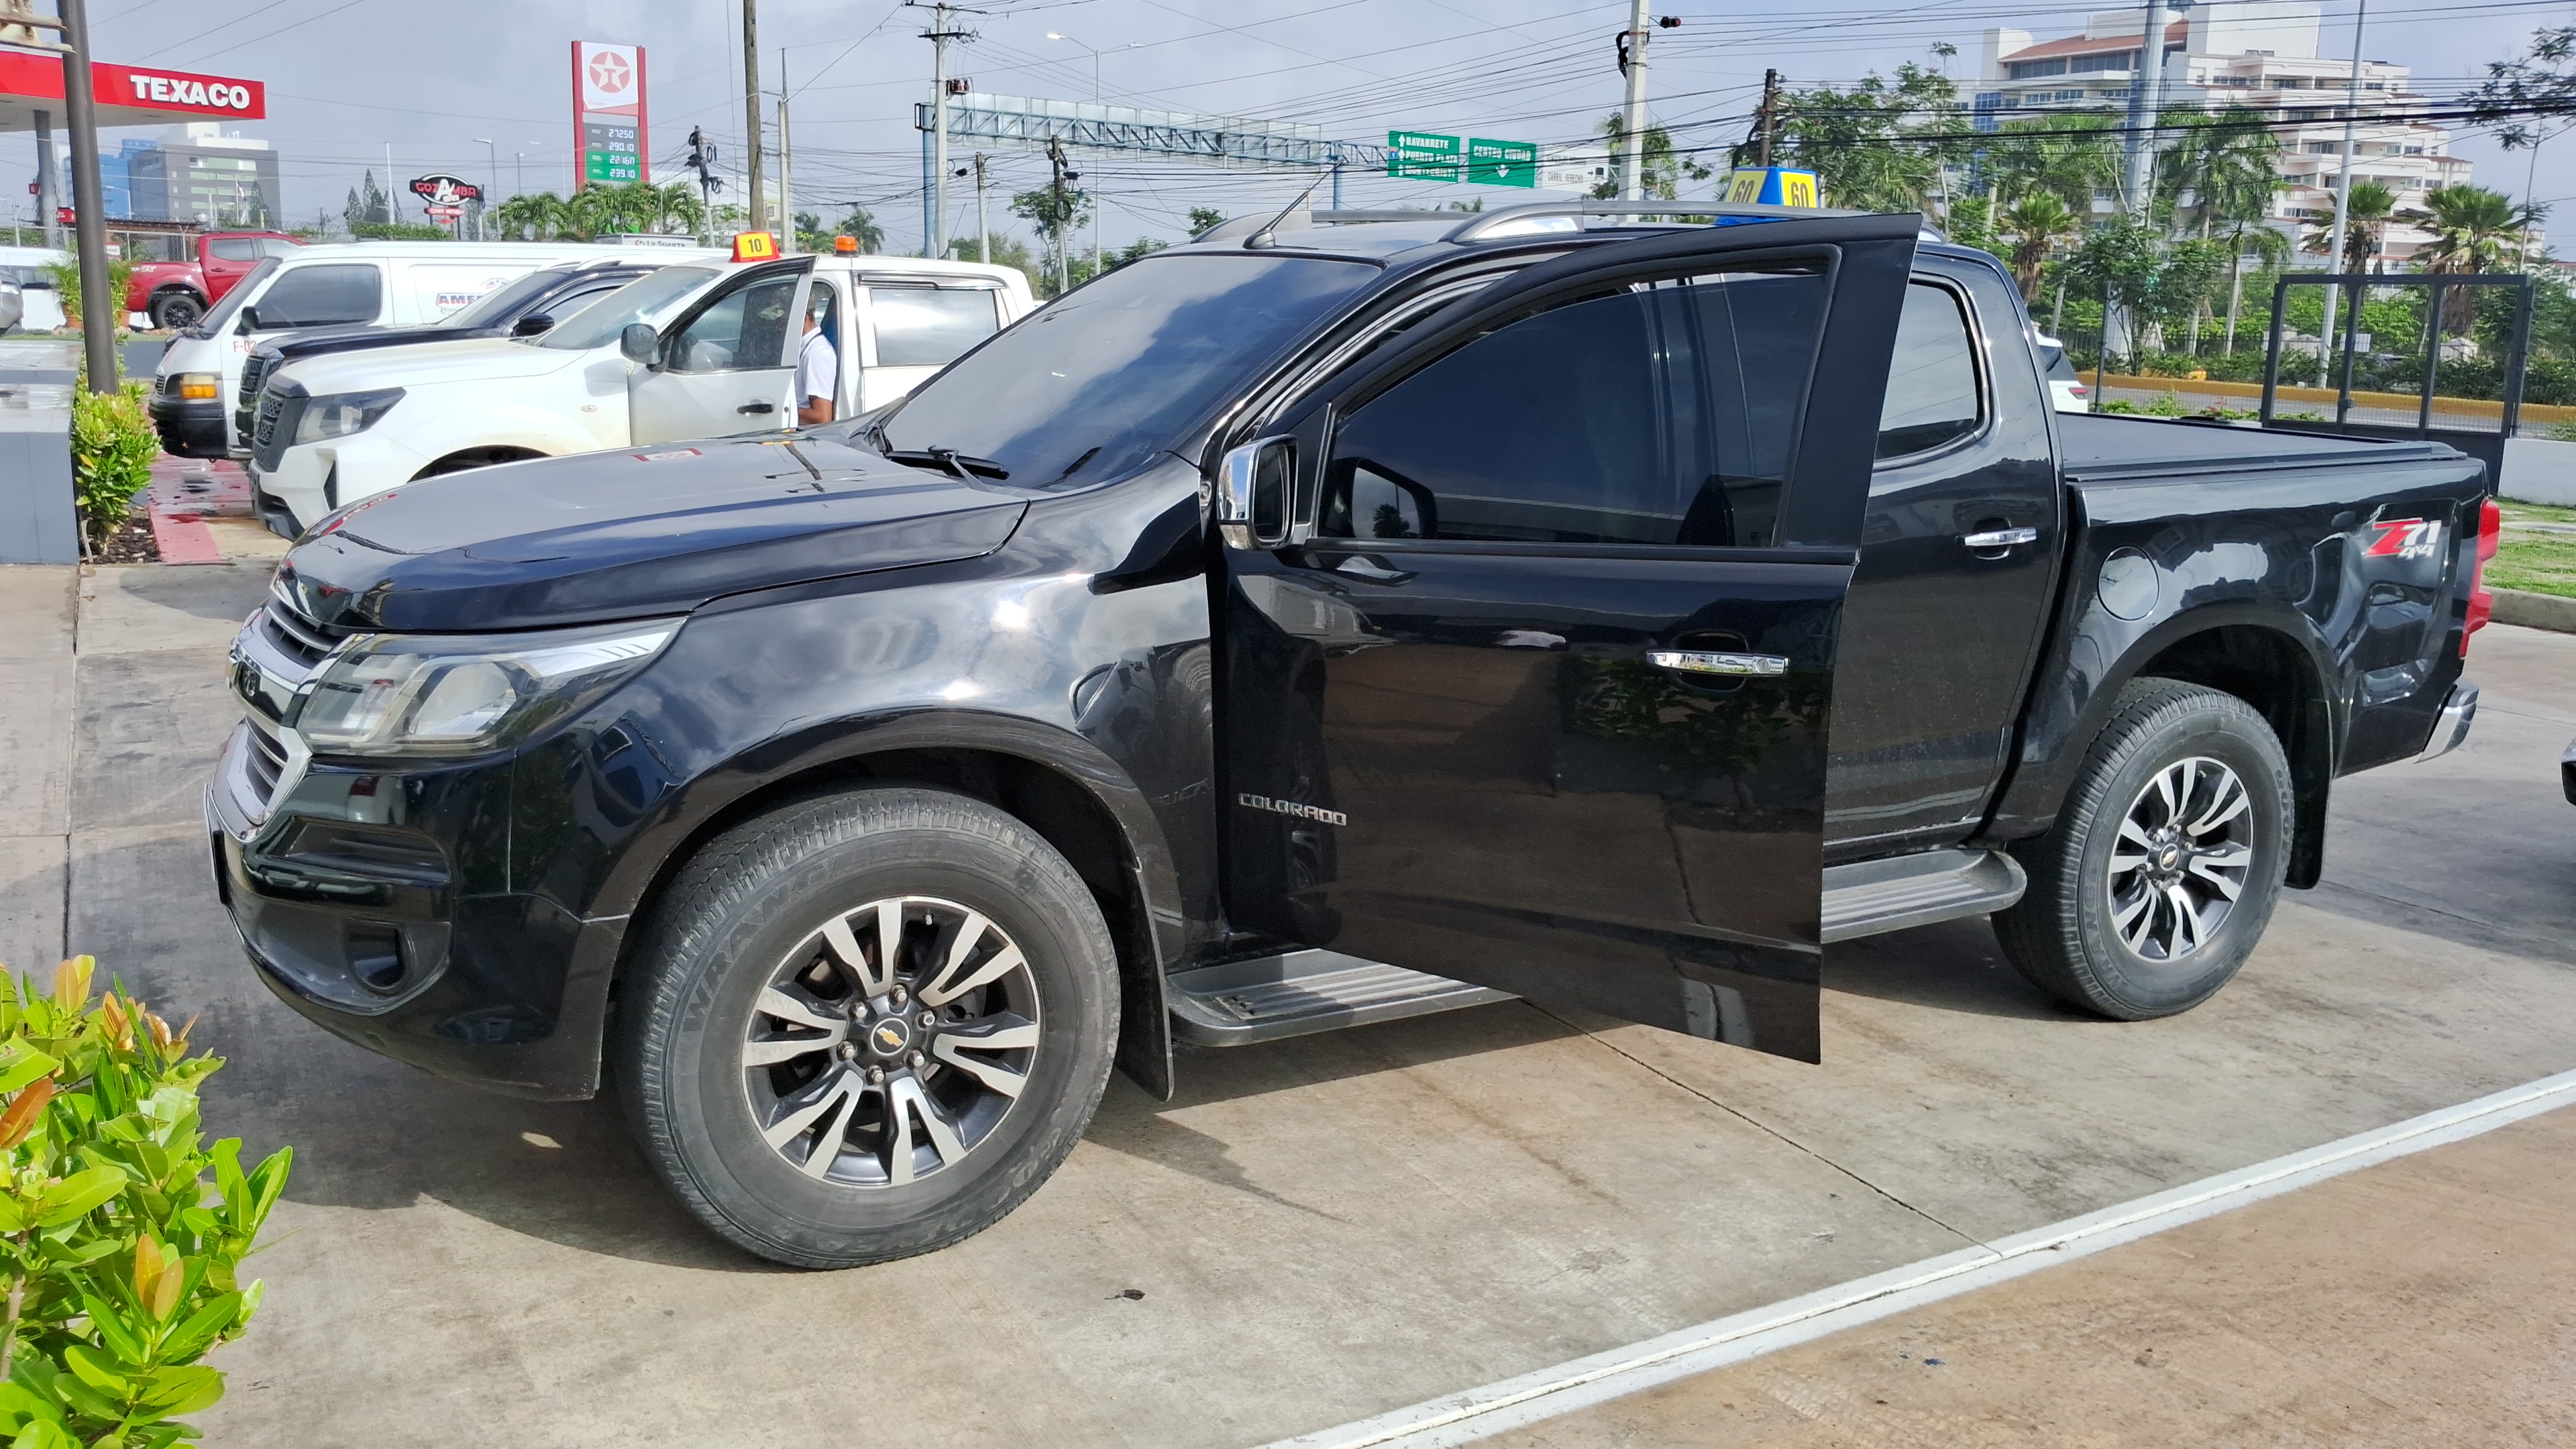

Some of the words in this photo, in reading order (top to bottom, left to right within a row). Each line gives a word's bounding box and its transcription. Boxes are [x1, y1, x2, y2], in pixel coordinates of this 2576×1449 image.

[130, 74, 250, 110] TEXACO
[1406, 136, 1449, 149] NAVARRETE
[1474, 145, 1502, 158] CENTRO
[1505, 148, 1531, 162] CIUDAD
[1405, 150, 1434, 162] PUERTO
[1436, 154, 1458, 164] PLATA
[1731, 179, 1755, 203] 60
[1790, 181, 1810, 207] 60
[747, 238, 763, 253] 10
[2367, 517, 2442, 557] Z71
[1238, 792, 1347, 826] COLORADO
